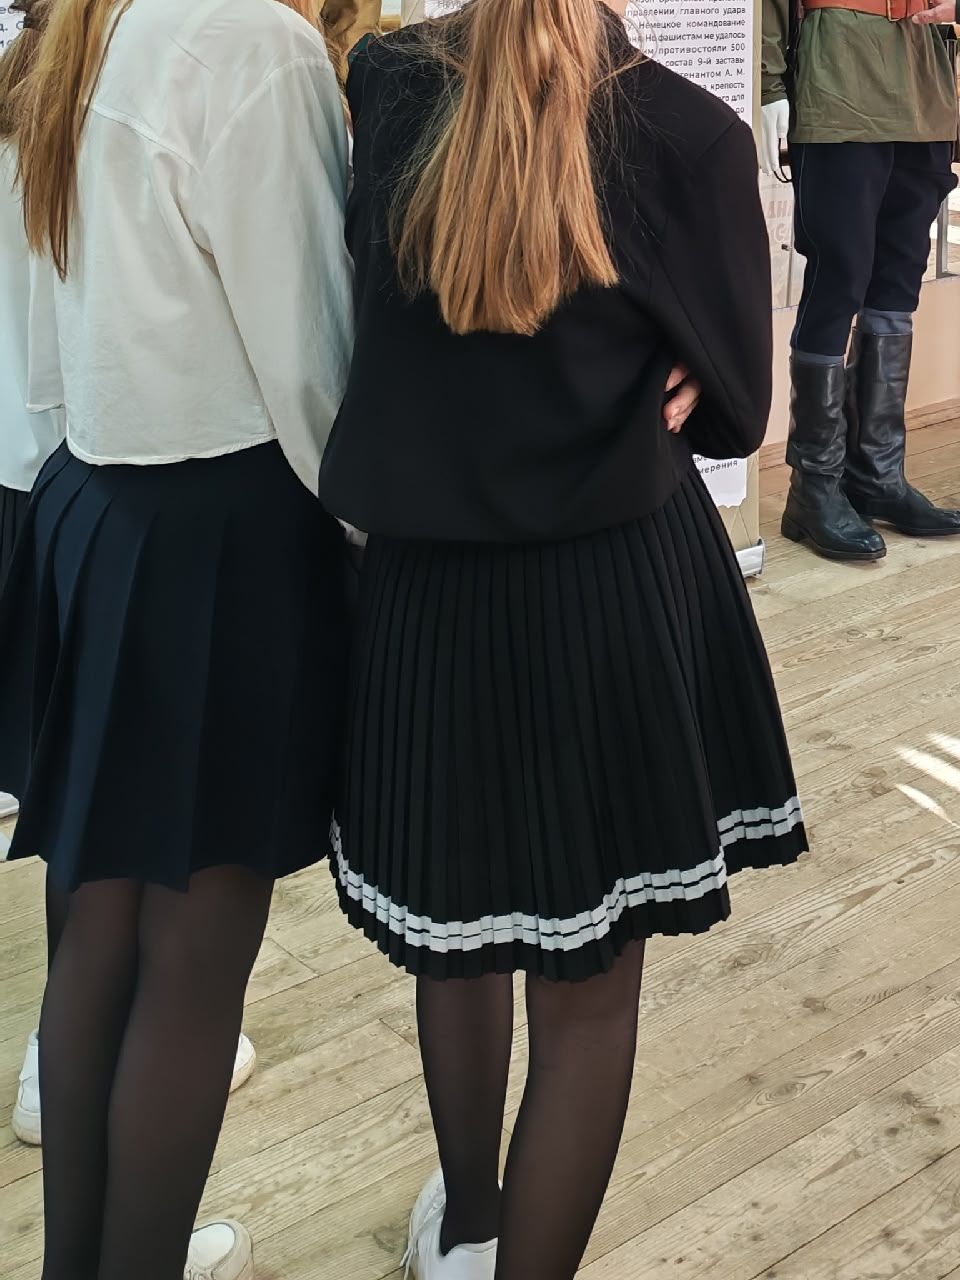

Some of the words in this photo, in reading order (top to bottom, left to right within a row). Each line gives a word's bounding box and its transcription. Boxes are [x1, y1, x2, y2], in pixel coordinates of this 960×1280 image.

[687, 20, 745, 28] командование
[658, 34, 702, 42] фашистам
[658, 45, 727, 55] противостояли
[666, 58, 692, 66] состав
[711, 83, 744, 91] крепость
